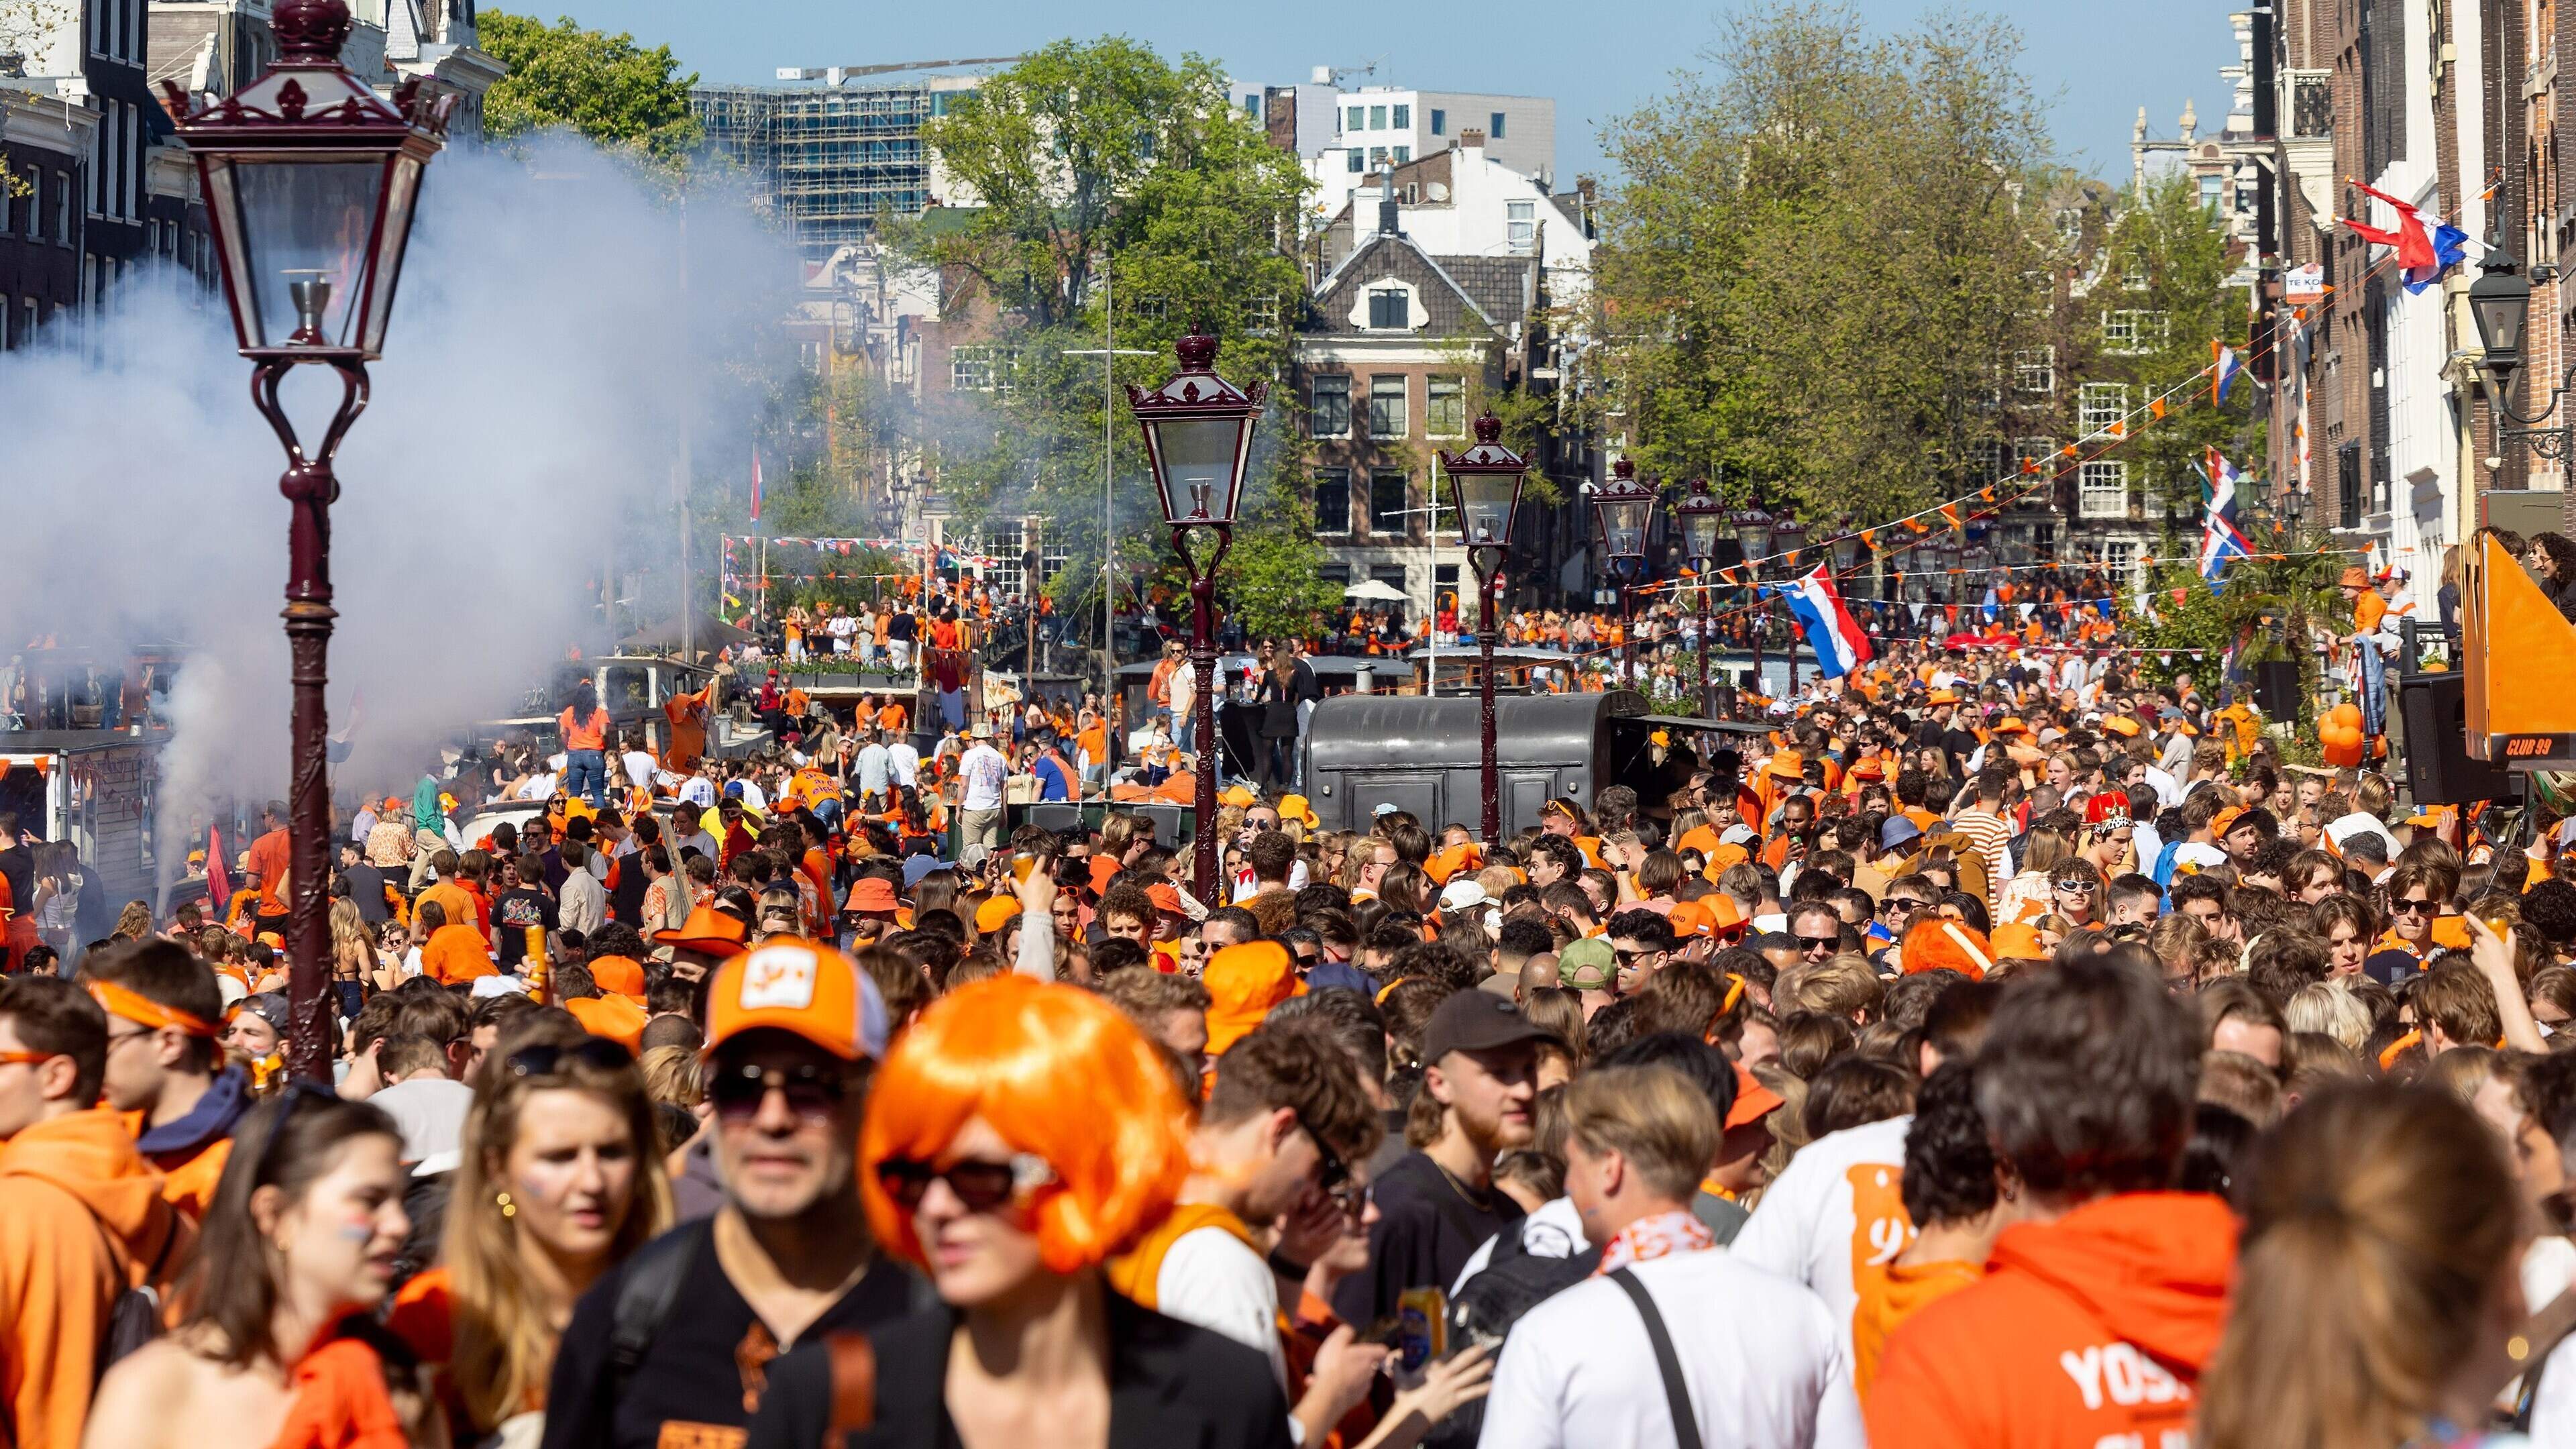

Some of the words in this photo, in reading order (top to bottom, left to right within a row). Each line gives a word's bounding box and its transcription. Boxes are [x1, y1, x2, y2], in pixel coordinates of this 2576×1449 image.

[2506, 739, 2536, 756] CLUB
[2535, 739, 2552, 755] 99
[2059, 1342, 2190, 1410] YOS
